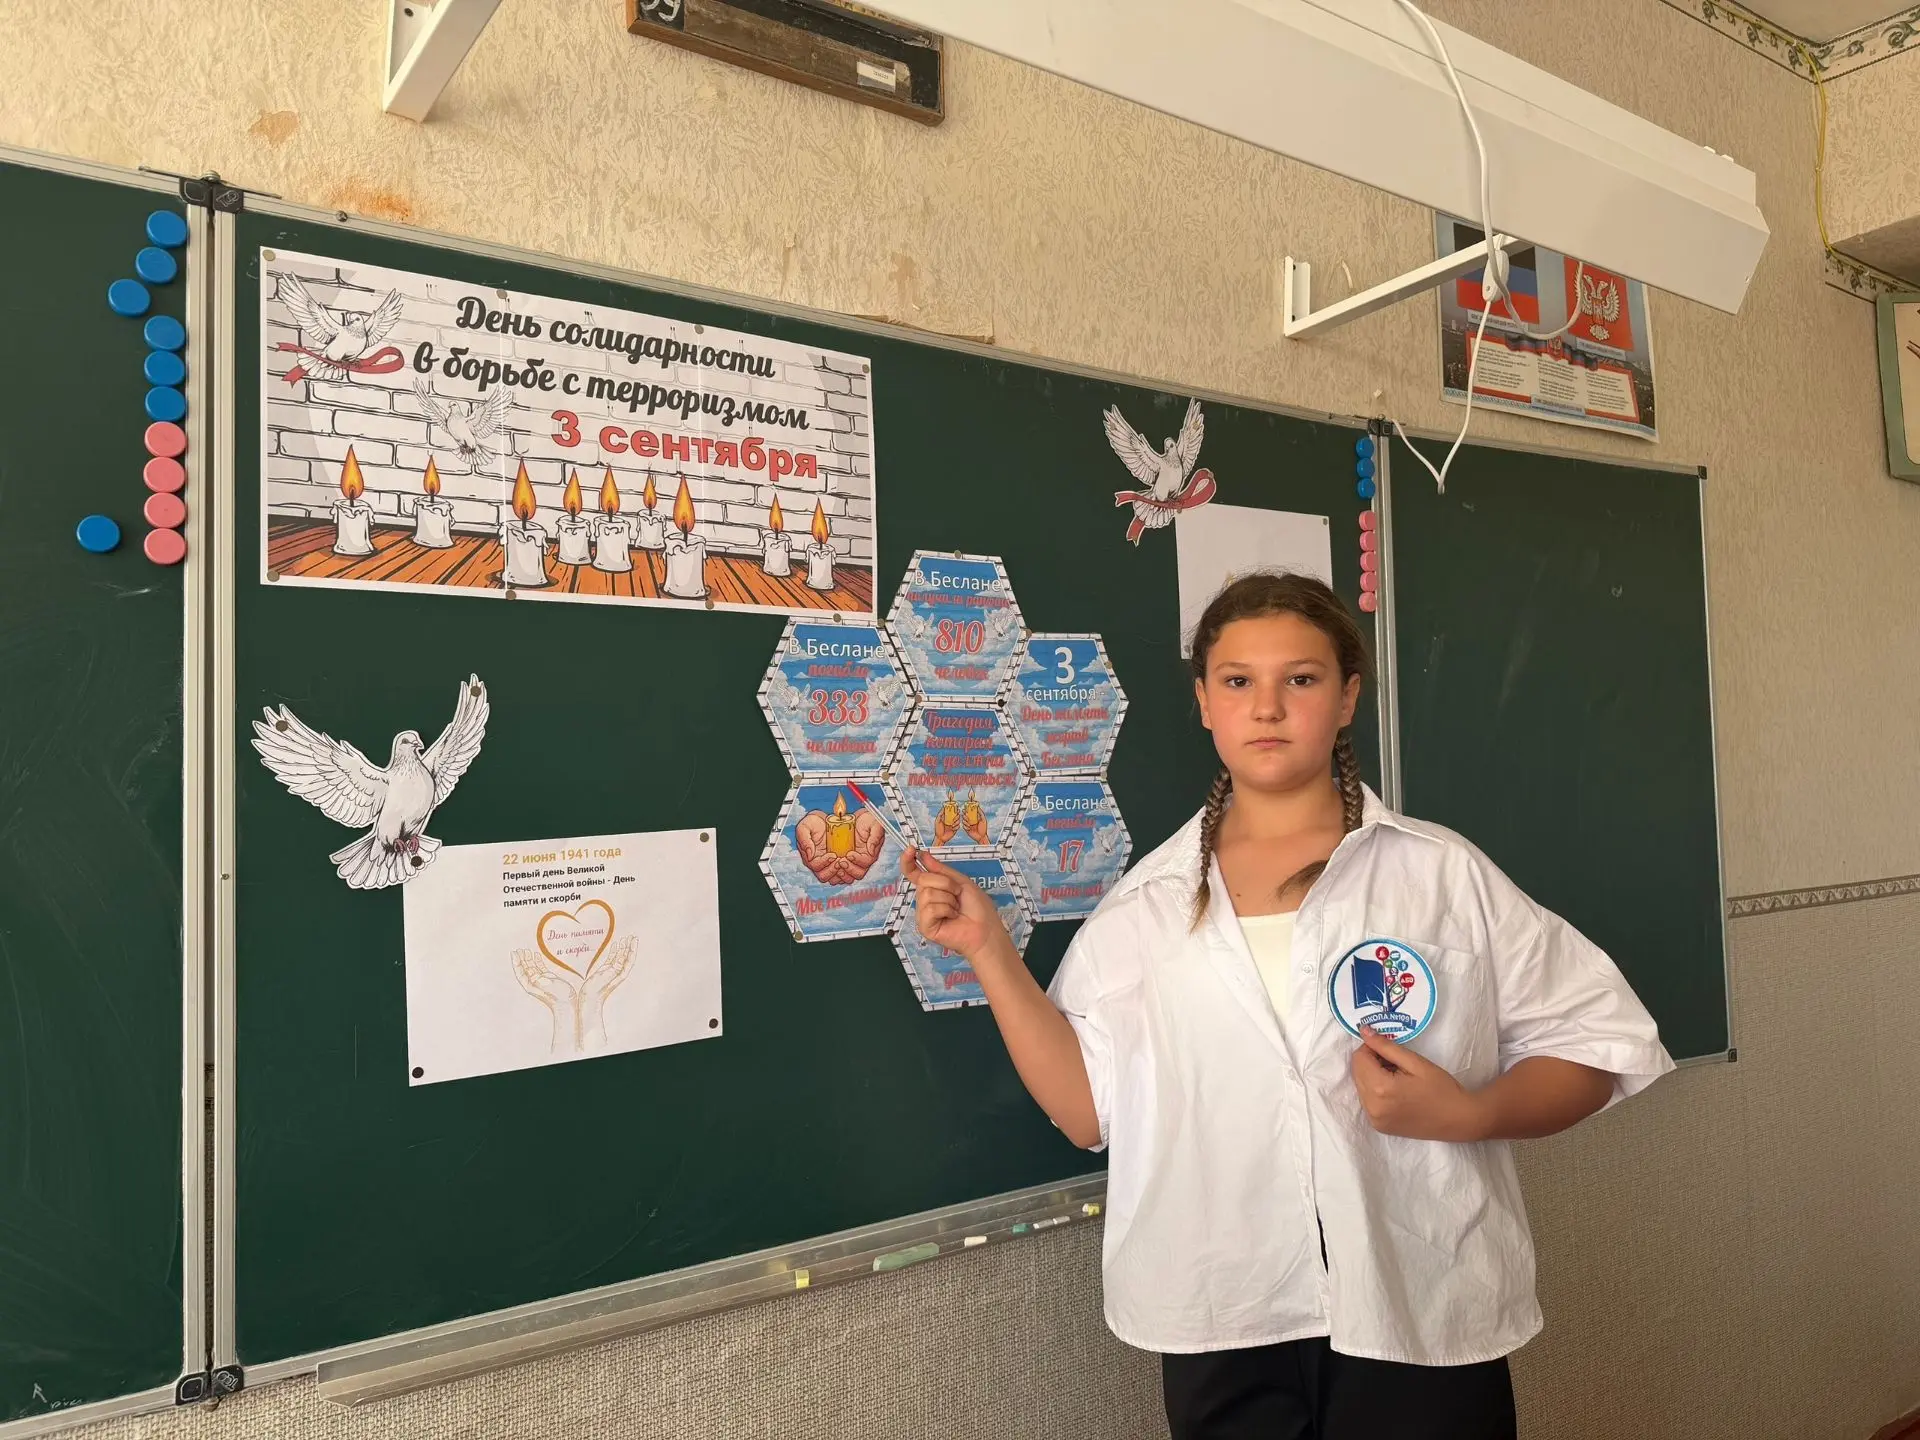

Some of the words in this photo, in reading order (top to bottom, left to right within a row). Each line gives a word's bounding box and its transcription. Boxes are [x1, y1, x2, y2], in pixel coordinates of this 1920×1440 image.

[455, 296, 542, 338] День
[549, 320, 776, 378] солидарности
[413, 341, 439, 374] в
[442, 347, 556, 392] борьбе
[562, 372, 581, 395] с
[586, 378, 810, 430] терроризмом
[551, 409, 581, 448] 3
[599, 424, 818, 481] сентября
[915, 570, 924, 586] В
[931, 571, 1002, 591] Беслане
[935, 619, 984, 654] 810
[788, 638, 800, 655] В
[807, 638, 885, 658] Беслане
[935, 664, 988, 680] человек
[1054, 646, 1075, 685] 3
[1026, 684, 1096, 703] сентября
[808, 689, 869, 725] 333
[1022, 705, 1053, 721] День
[924, 737, 993, 753] которая
[923, 754, 937, 767] не
[944, 755, 1005, 772] должна
[1031, 796, 1040, 810] В
[1046, 796, 1109, 810] Беслане
[503, 854, 518, 865] 22
[522, 852, 556, 864] июня
[561, 849, 589, 861] 1941
[594, 847, 622, 859] года
[1059, 839, 1084, 872] 17
[503, 869, 541, 881] Первый
[543, 868, 565, 879] день
[567, 863, 605, 875] Великой
[503, 880, 575, 894] Отечественной
[577, 877, 605, 888] войны
[613, 875, 636, 886] День
[503, 898, 539, 908] памяти
[541, 895, 547, 904] и
[548, 893, 581, 904] скорби
[796, 896, 824, 916] Мы
[547, 930, 568, 940] День
[570, 929, 604, 938] памяти
[565, 943, 590, 957] скорби
[1361, 1013, 1389, 1025] ШКОЛА
